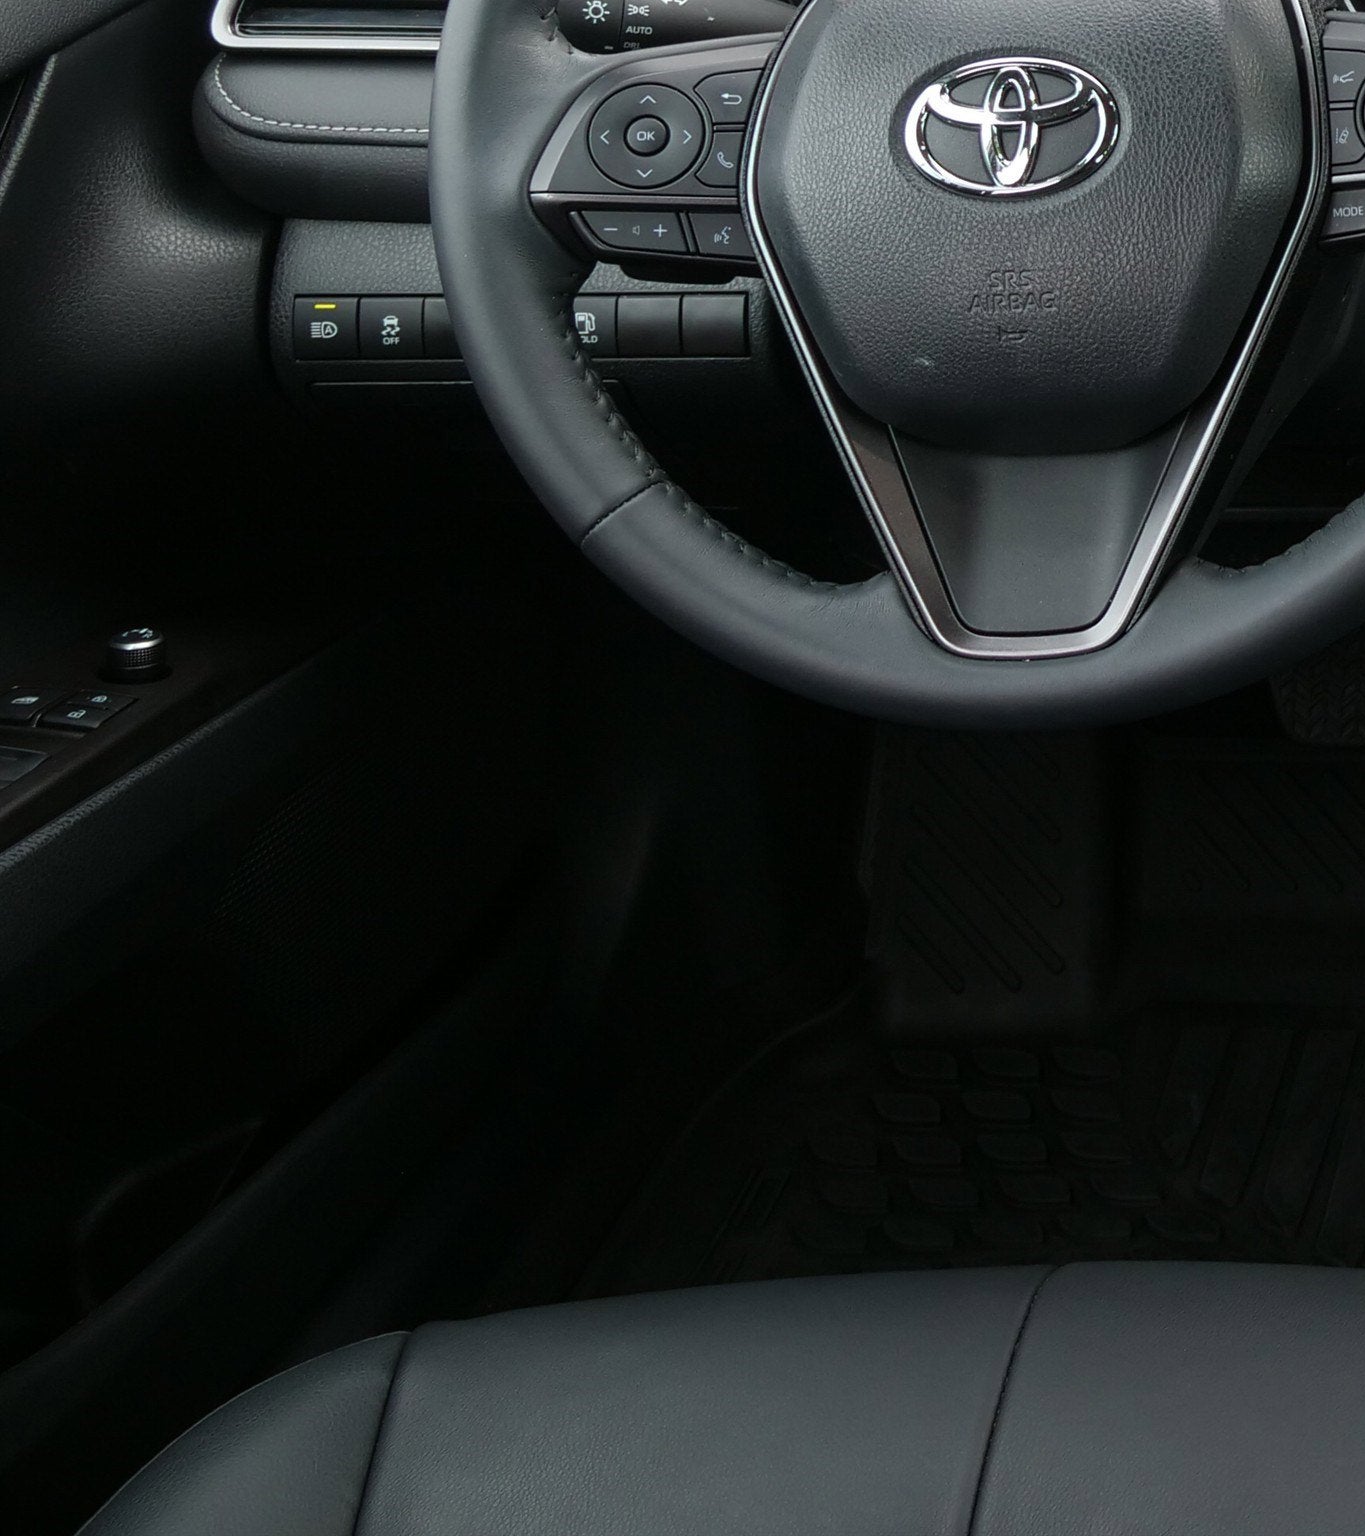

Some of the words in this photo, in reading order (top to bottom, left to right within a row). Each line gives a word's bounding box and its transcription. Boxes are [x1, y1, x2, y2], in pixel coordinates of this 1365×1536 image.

[625, 25, 653, 35] AUTO
[637, 131, 656, 141] OK
[1333, 206, 1364, 217] MODE
[989, 270, 1033, 290] SRS
[969, 292, 1057, 314] AIRBAG
[383, 336, 400, 345] OFF
